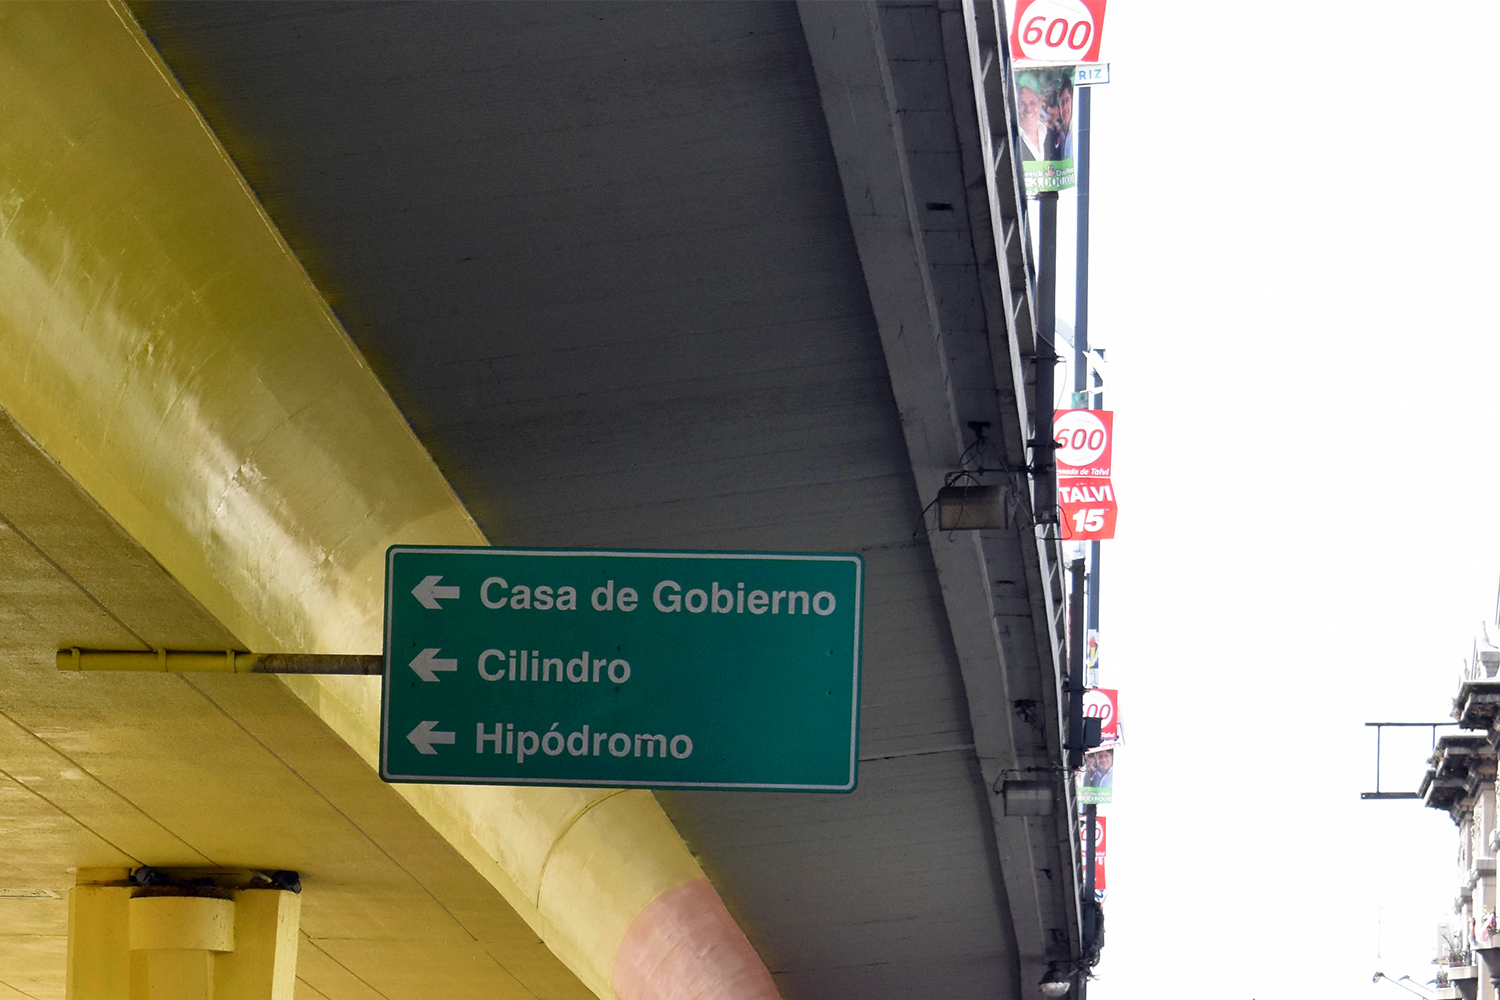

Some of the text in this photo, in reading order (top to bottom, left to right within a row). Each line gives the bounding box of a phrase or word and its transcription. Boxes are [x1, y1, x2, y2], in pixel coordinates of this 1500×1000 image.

[1022, 15, 1092, 50] 600
[1054, 428, 1104, 450] 600
[1059, 485, 1113, 504] TALVI
[1073, 508, 1104, 532] 15
[479, 576, 836, 616] Casa de Gobierno
[477, 649, 631, 684] Cilindro
[474, 722, 693, 764] Hipódromo
